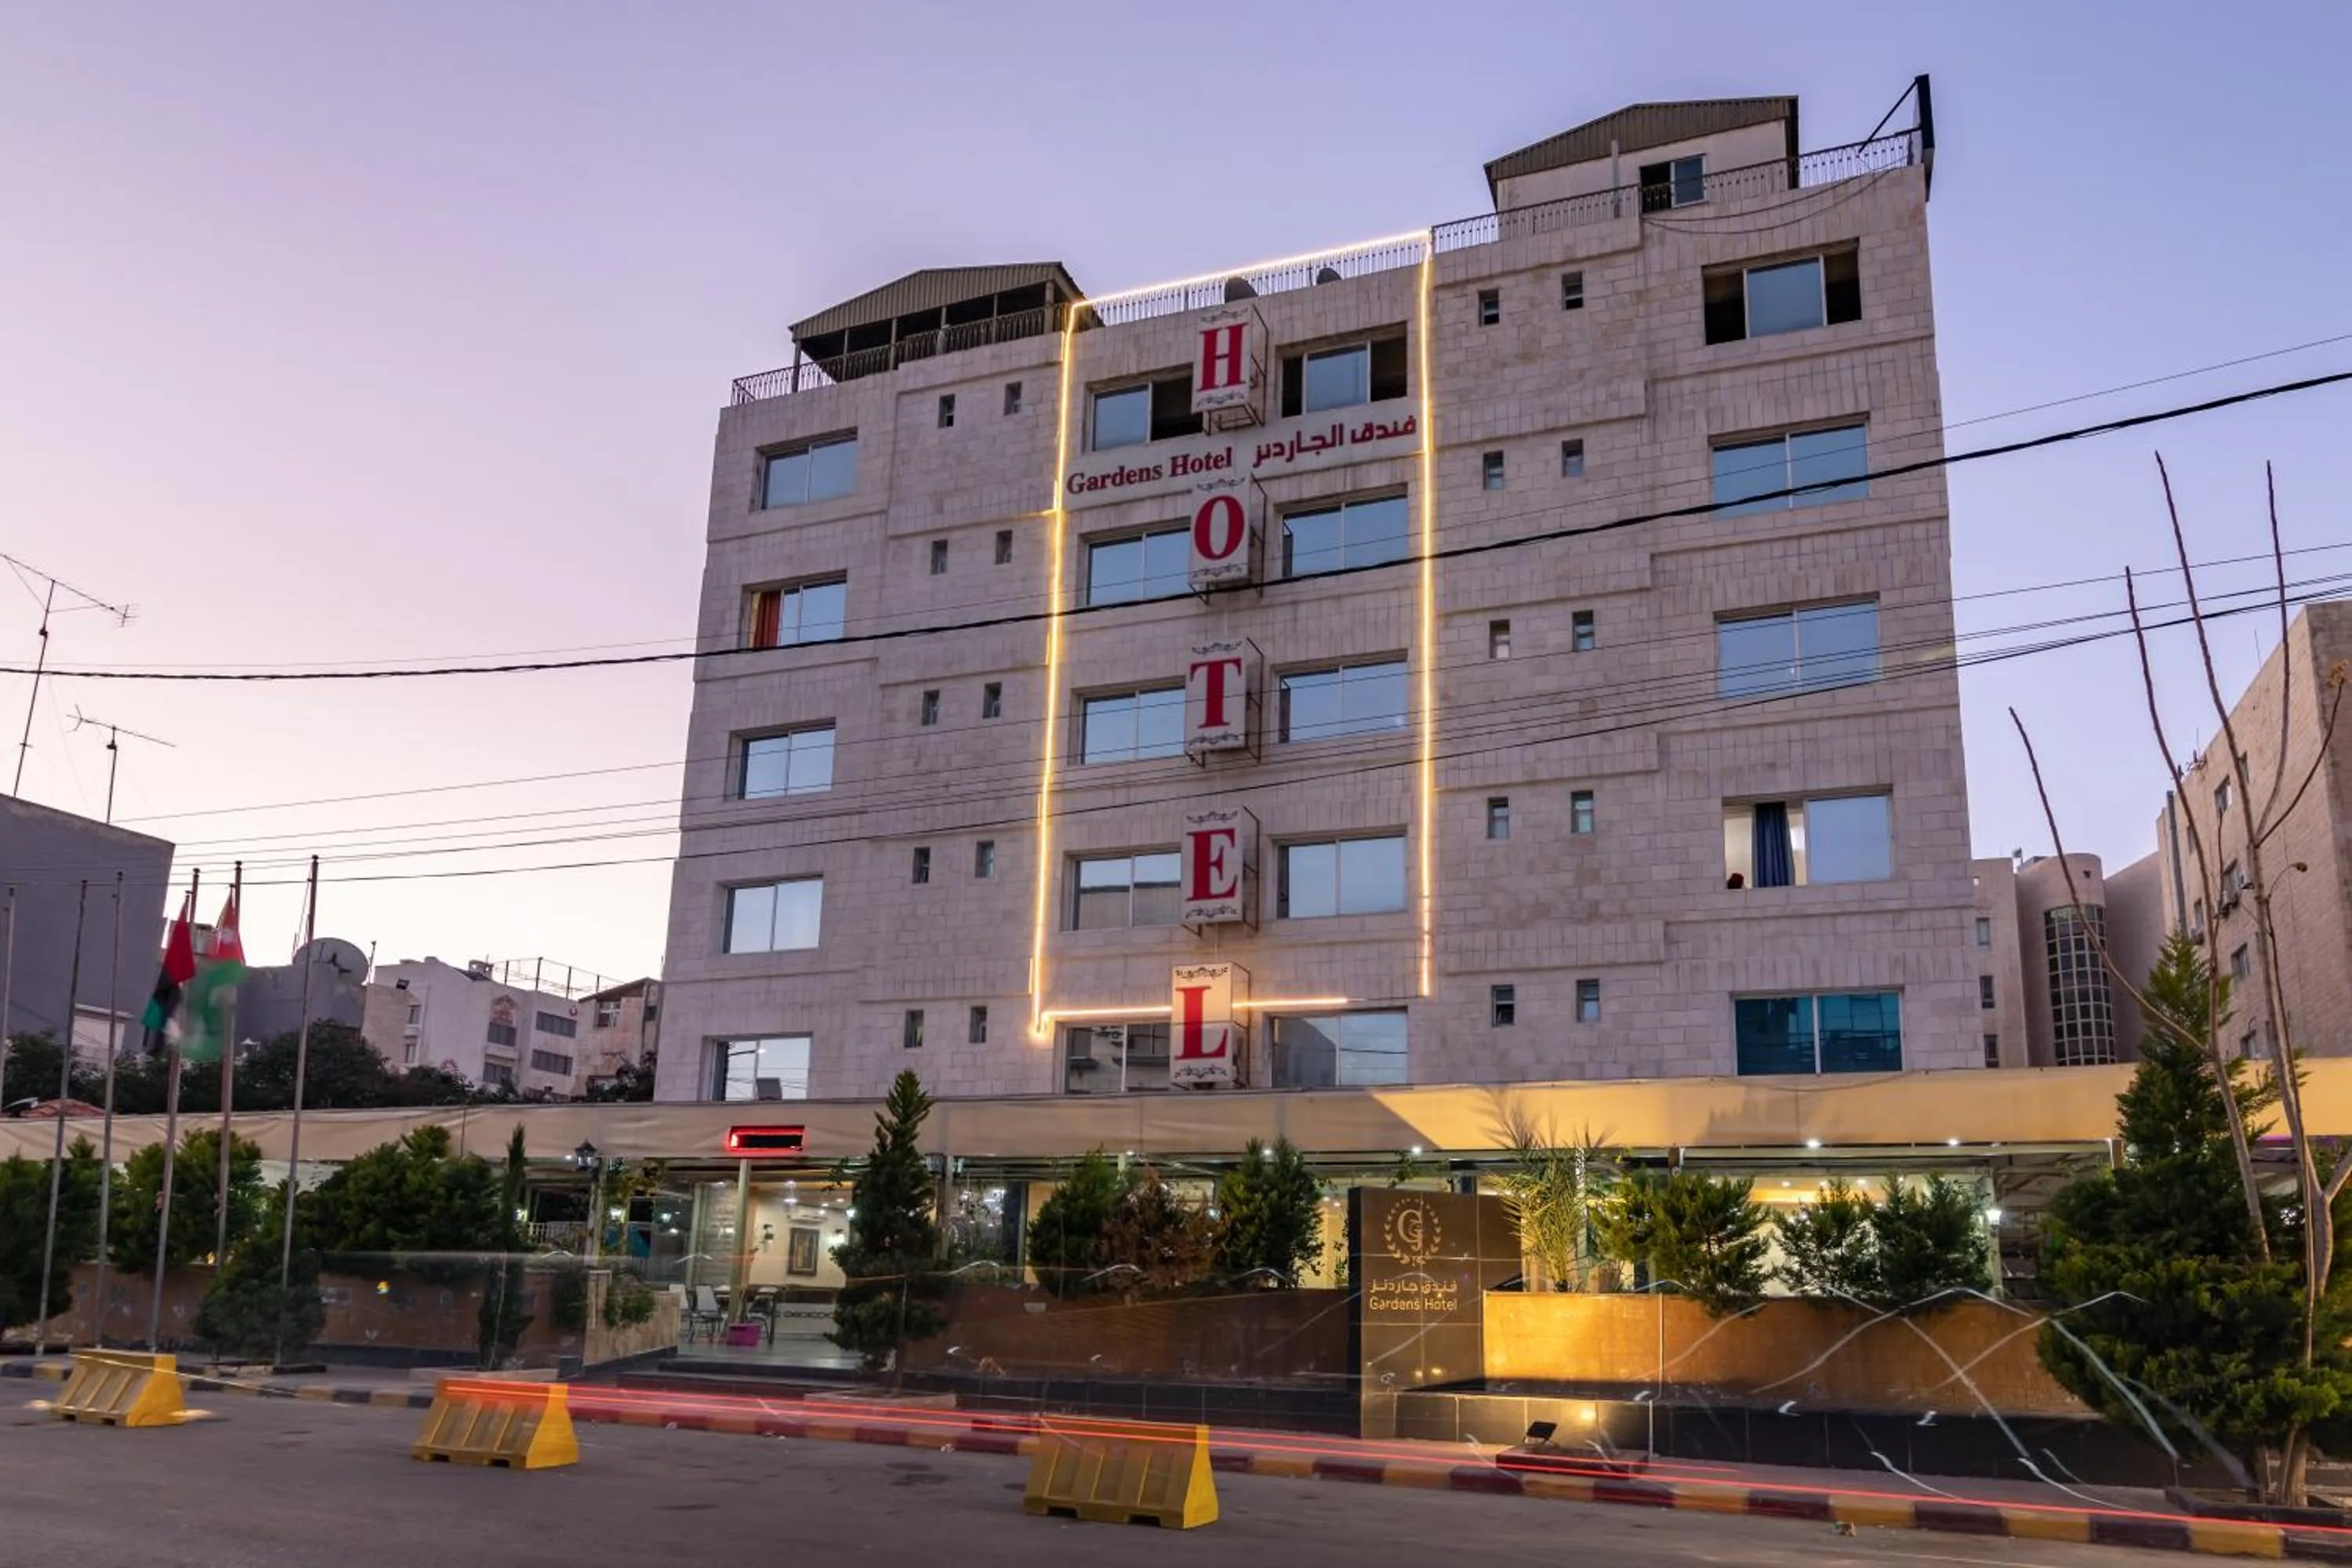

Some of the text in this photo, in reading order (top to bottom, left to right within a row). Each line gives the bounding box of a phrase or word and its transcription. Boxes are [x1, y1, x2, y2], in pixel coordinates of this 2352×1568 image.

[1253, 414, 1417, 468] فندق الجاردنز
[1067, 446, 1232, 494] Gardens Hotel
[1175, 321, 1248, 1060] HOTEL
[1369, 1296, 1457, 1311] Gardens Hotel
[1370, 1279, 1457, 1294] فندق جاردنز
